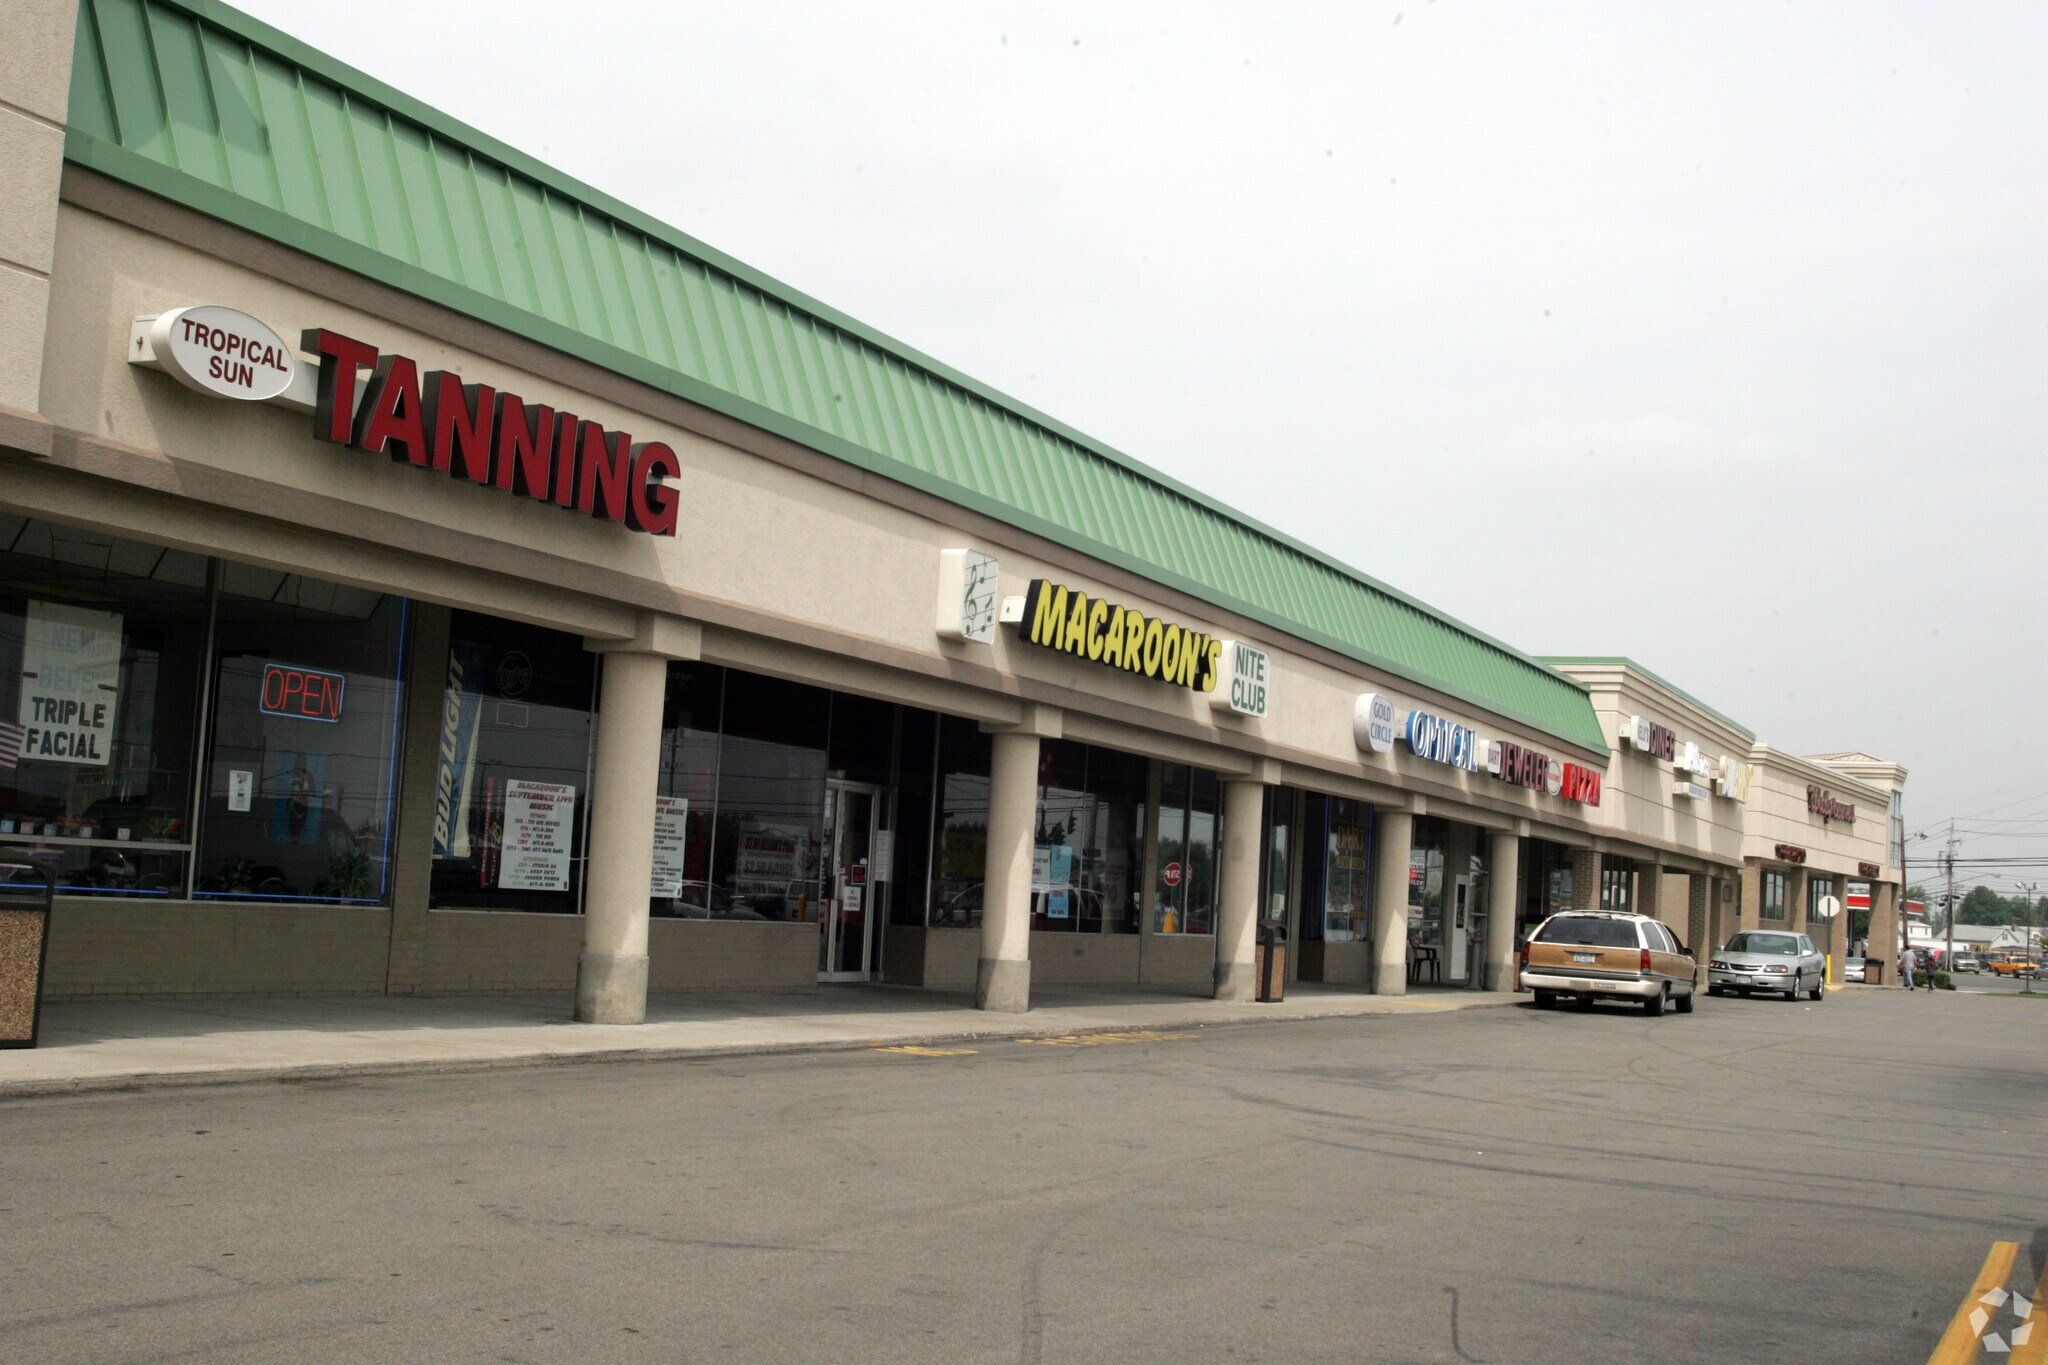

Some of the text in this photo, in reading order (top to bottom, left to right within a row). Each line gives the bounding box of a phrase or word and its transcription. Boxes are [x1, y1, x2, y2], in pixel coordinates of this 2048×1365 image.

[181, 318, 288, 373] TROPICAL
[209, 355, 254, 389] SUN
[303, 327, 681, 537] TANNING
[1029, 578, 1223, 694] MACAROON'S
[1235, 645, 1266, 682] NITE
[32, 696, 107, 729] TRIPLE
[263, 669, 341, 718] OPEN
[441, 648, 465, 766] LIGHT
[1231, 676, 1267, 715] CLUB
[1374, 701, 1391, 721] GOLD
[25, 728, 101, 760] FACIAL
[1370, 720, 1392, 744] CIRCLE
[1411, 709, 1479, 772] OPTICAL
[1650, 721, 1675, 762] DINER
[1487, 747, 1500, 766] DART
[508, 791, 574, 804] SEPTEMBER LIVE
[1566, 763, 1601, 807] PIZZA
[434, 769, 453, 851] BUD
[529, 802, 554, 811] MUSIC
